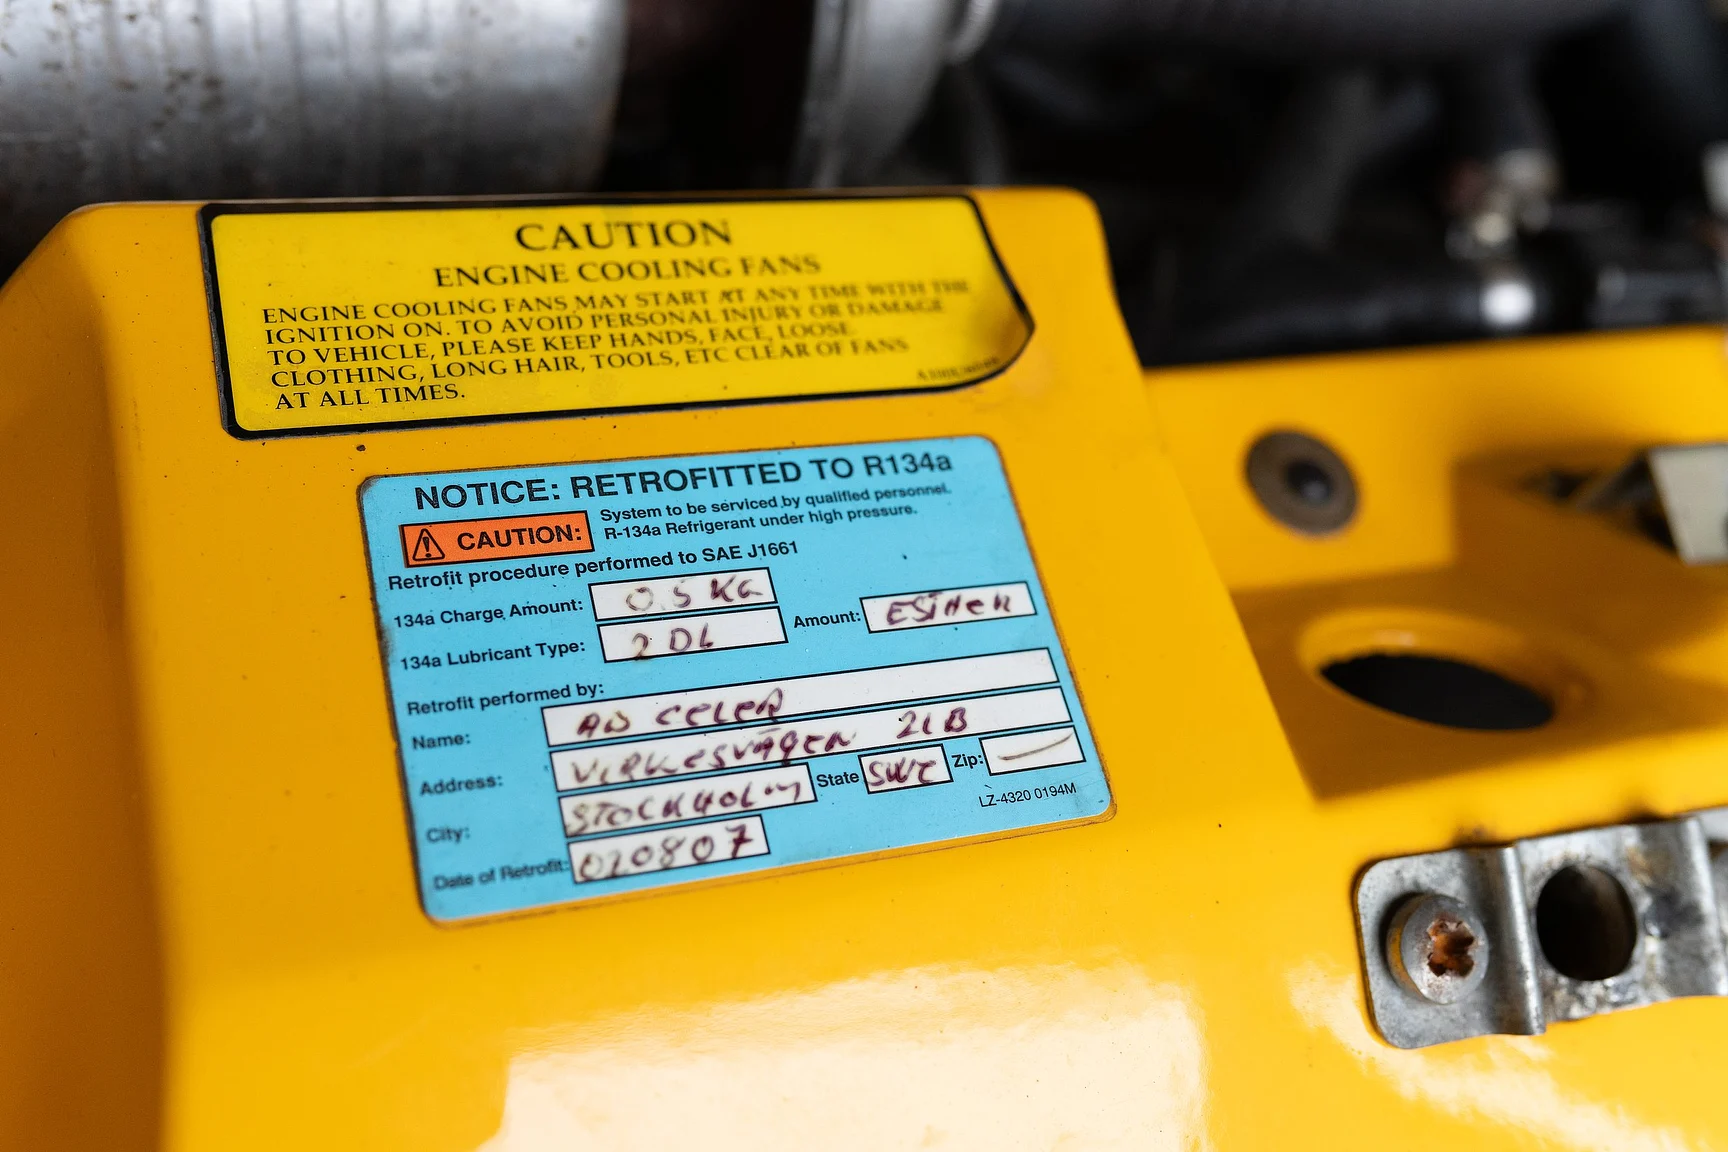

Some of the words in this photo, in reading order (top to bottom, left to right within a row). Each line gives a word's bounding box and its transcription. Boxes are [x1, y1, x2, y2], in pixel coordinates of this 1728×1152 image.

[516, 220, 731, 251] CAUTION
[435, 263, 571, 288] ENGINE
[578, 258, 732, 284] COOLING
[741, 254, 821, 275] FANS
[263, 304, 366, 323] ENGINE
[374, 300, 496, 319] COOLING
[505, 296, 568, 313] FANS
[575, 292, 628, 311] MAY
[636, 291, 712, 307] START
[719, 289, 745, 304] AT
[755, 287, 803, 302] ANY
[809, 284, 860, 300] TIME
[866, 281, 927, 297] WITH
[932, 279, 970, 294] THE
[265, 323, 396, 344] IGNITION
[404, 321, 449, 337] ON.
[456, 319, 493, 334] TO
[501, 312, 582, 333] AVOID
[590, 310, 720, 328] PERSONAL
[722, 306, 803, 325] INJURY
[810, 303, 843, 318] OR
[848, 299, 945, 316] DAMAGE
[268, 350, 305, 366] TO
[313, 343, 436, 364] VEHICLE,
[443, 337, 536, 356] PLEASE
[543, 334, 602, 350] KEEP
[610, 330, 705, 348] HANDS,
[710, 326, 774, 344] FACE,
[779, 321, 849, 340] LOOSE
[271, 365, 425, 387] CLOTHING,
[432, 358, 507, 378] LONG
[516, 355, 585, 374] HAIR,
[592, 351, 680, 369] TOOLS,
[686, 348, 731, 364] ETC
[735, 344, 810, 362] CLEAR
[815, 340, 843, 356] OF
[848, 338, 909, 354] FANS
[276, 391, 310, 409] AT
[320, 388, 370, 407] ALL
[379, 383, 465, 404] TIMES.
[415, 477, 560, 509] NOTICE:
[572, 462, 801, 499] RETROFITTED
[810, 457, 854, 481] TO
[863, 452, 953, 476] R134a
[601, 505, 662, 523] System
[666, 503, 683, 516] to
[687, 499, 707, 515] be
[711, 494, 777, 513] serviced
[780, 492, 800, 508] by
[806, 487, 870, 505] qualified
[874, 484, 952, 500] personnel.
[457, 524, 582, 550] CAUTION:
[605, 523, 662, 540] R-134a
[666, 516, 755, 535] Refrigerant
[760, 511, 804, 527] under
[808, 507, 844, 524] high
[848, 504, 918, 521] pressure.
[388, 571, 464, 590] Retrofit
[468, 561, 570, 587] procedure
[575, 553, 675, 578] performed
[678, 550, 697, 564] to
[703, 545, 743, 562] SAE
[747, 541, 798, 559] J1661
[394, 611, 435, 628] 134a
[440, 607, 505, 626] Charge
[509, 599, 582, 617] Amount:
[794, 610, 861, 628] Amount:
[400, 653, 442, 670] 134a
[447, 644, 531, 666] Lubricant
[535, 639, 584, 658] Type:
[407, 695, 474, 715] Retrofit
[479, 687, 571, 711] performed
[576, 682, 604, 700] by:
[412, 733, 471, 749] Name:
[952, 752, 983, 769] Zip:
[420, 774, 503, 796] Address:
[817, 770, 859, 787] State
[979, 789, 1031, 807] LZ-4320
[1034, 782, 1077, 799] 0194M
[426, 826, 471, 844] City:
[434, 872, 473, 889] Date
[478, 867, 496, 882] of
[500, 858, 570, 881] Retrofit:
